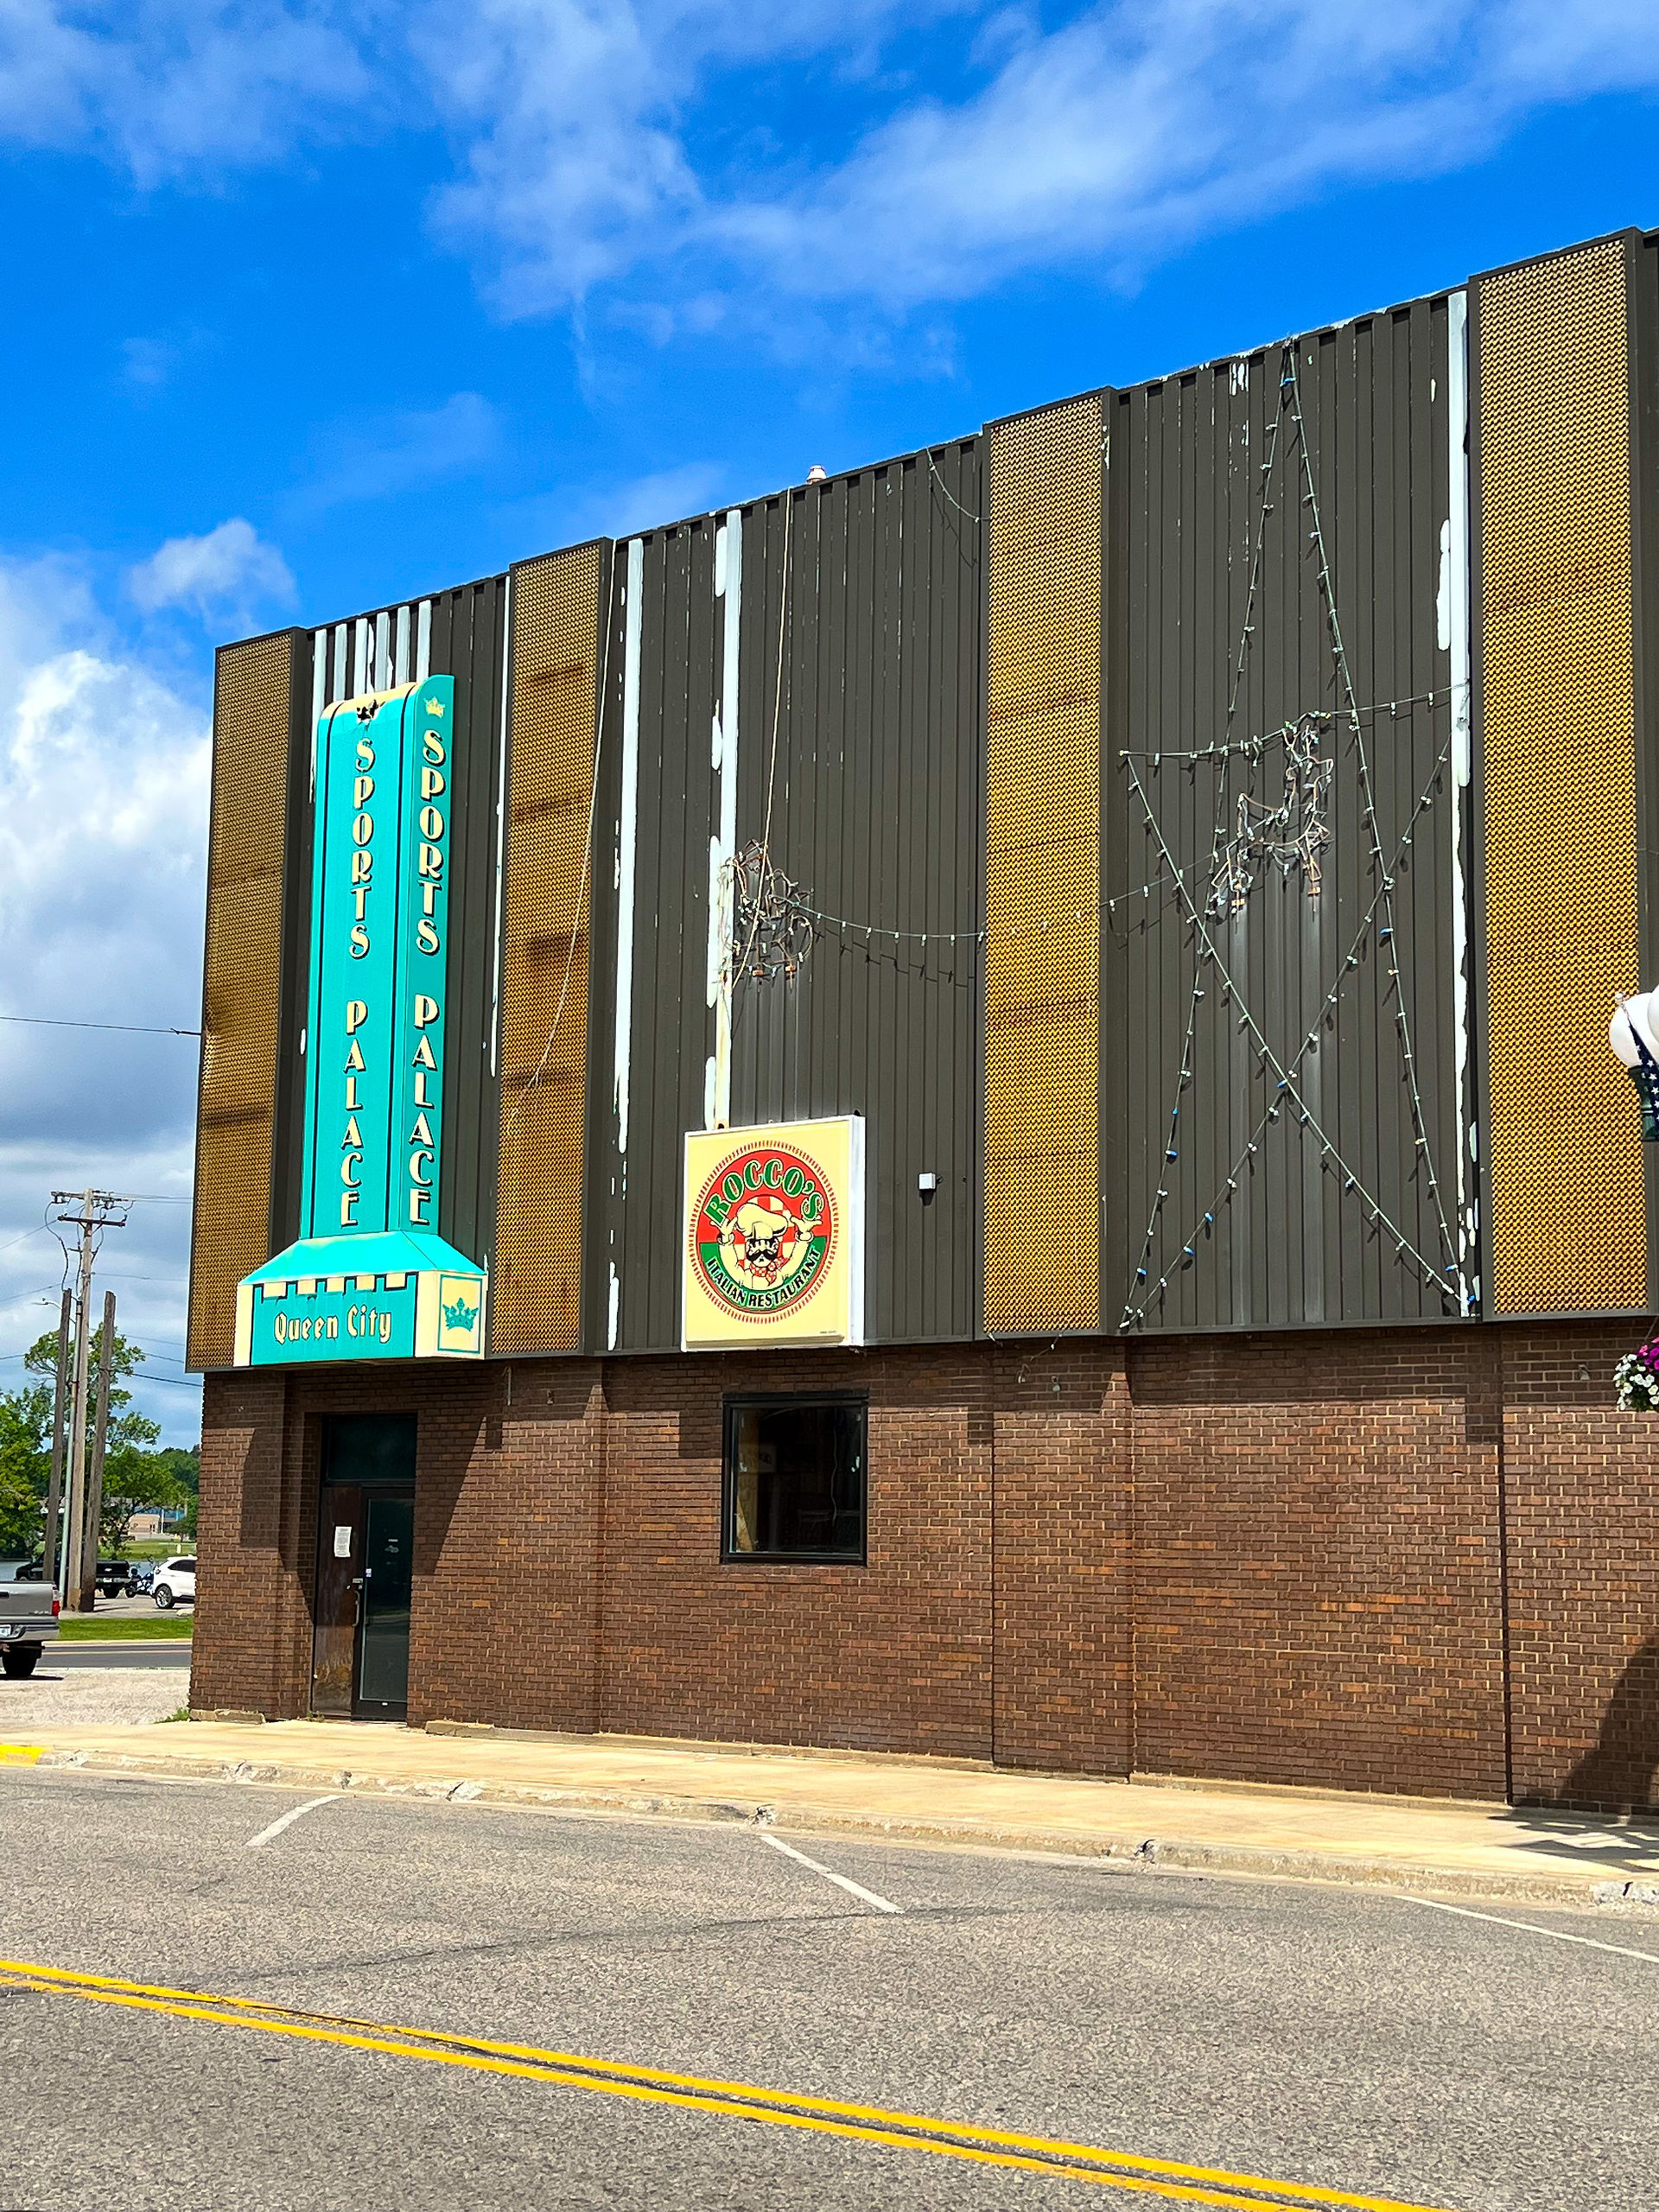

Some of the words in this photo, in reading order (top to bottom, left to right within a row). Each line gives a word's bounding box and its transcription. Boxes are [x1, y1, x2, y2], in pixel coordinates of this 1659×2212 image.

[349, 737, 375, 959] SPORTS
[416, 729, 446, 957] SPORTS
[340, 1000, 367, 1229] PALACE
[409, 994, 440, 1225] PALACE
[704, 1158, 824, 1226] ROCCO'S
[274, 1312, 339, 1345] Queen
[346, 1304, 391, 1344] City
[707, 1258, 745, 1304] ITALIAN
[748, 1246, 820, 1307] RESTAURANT
